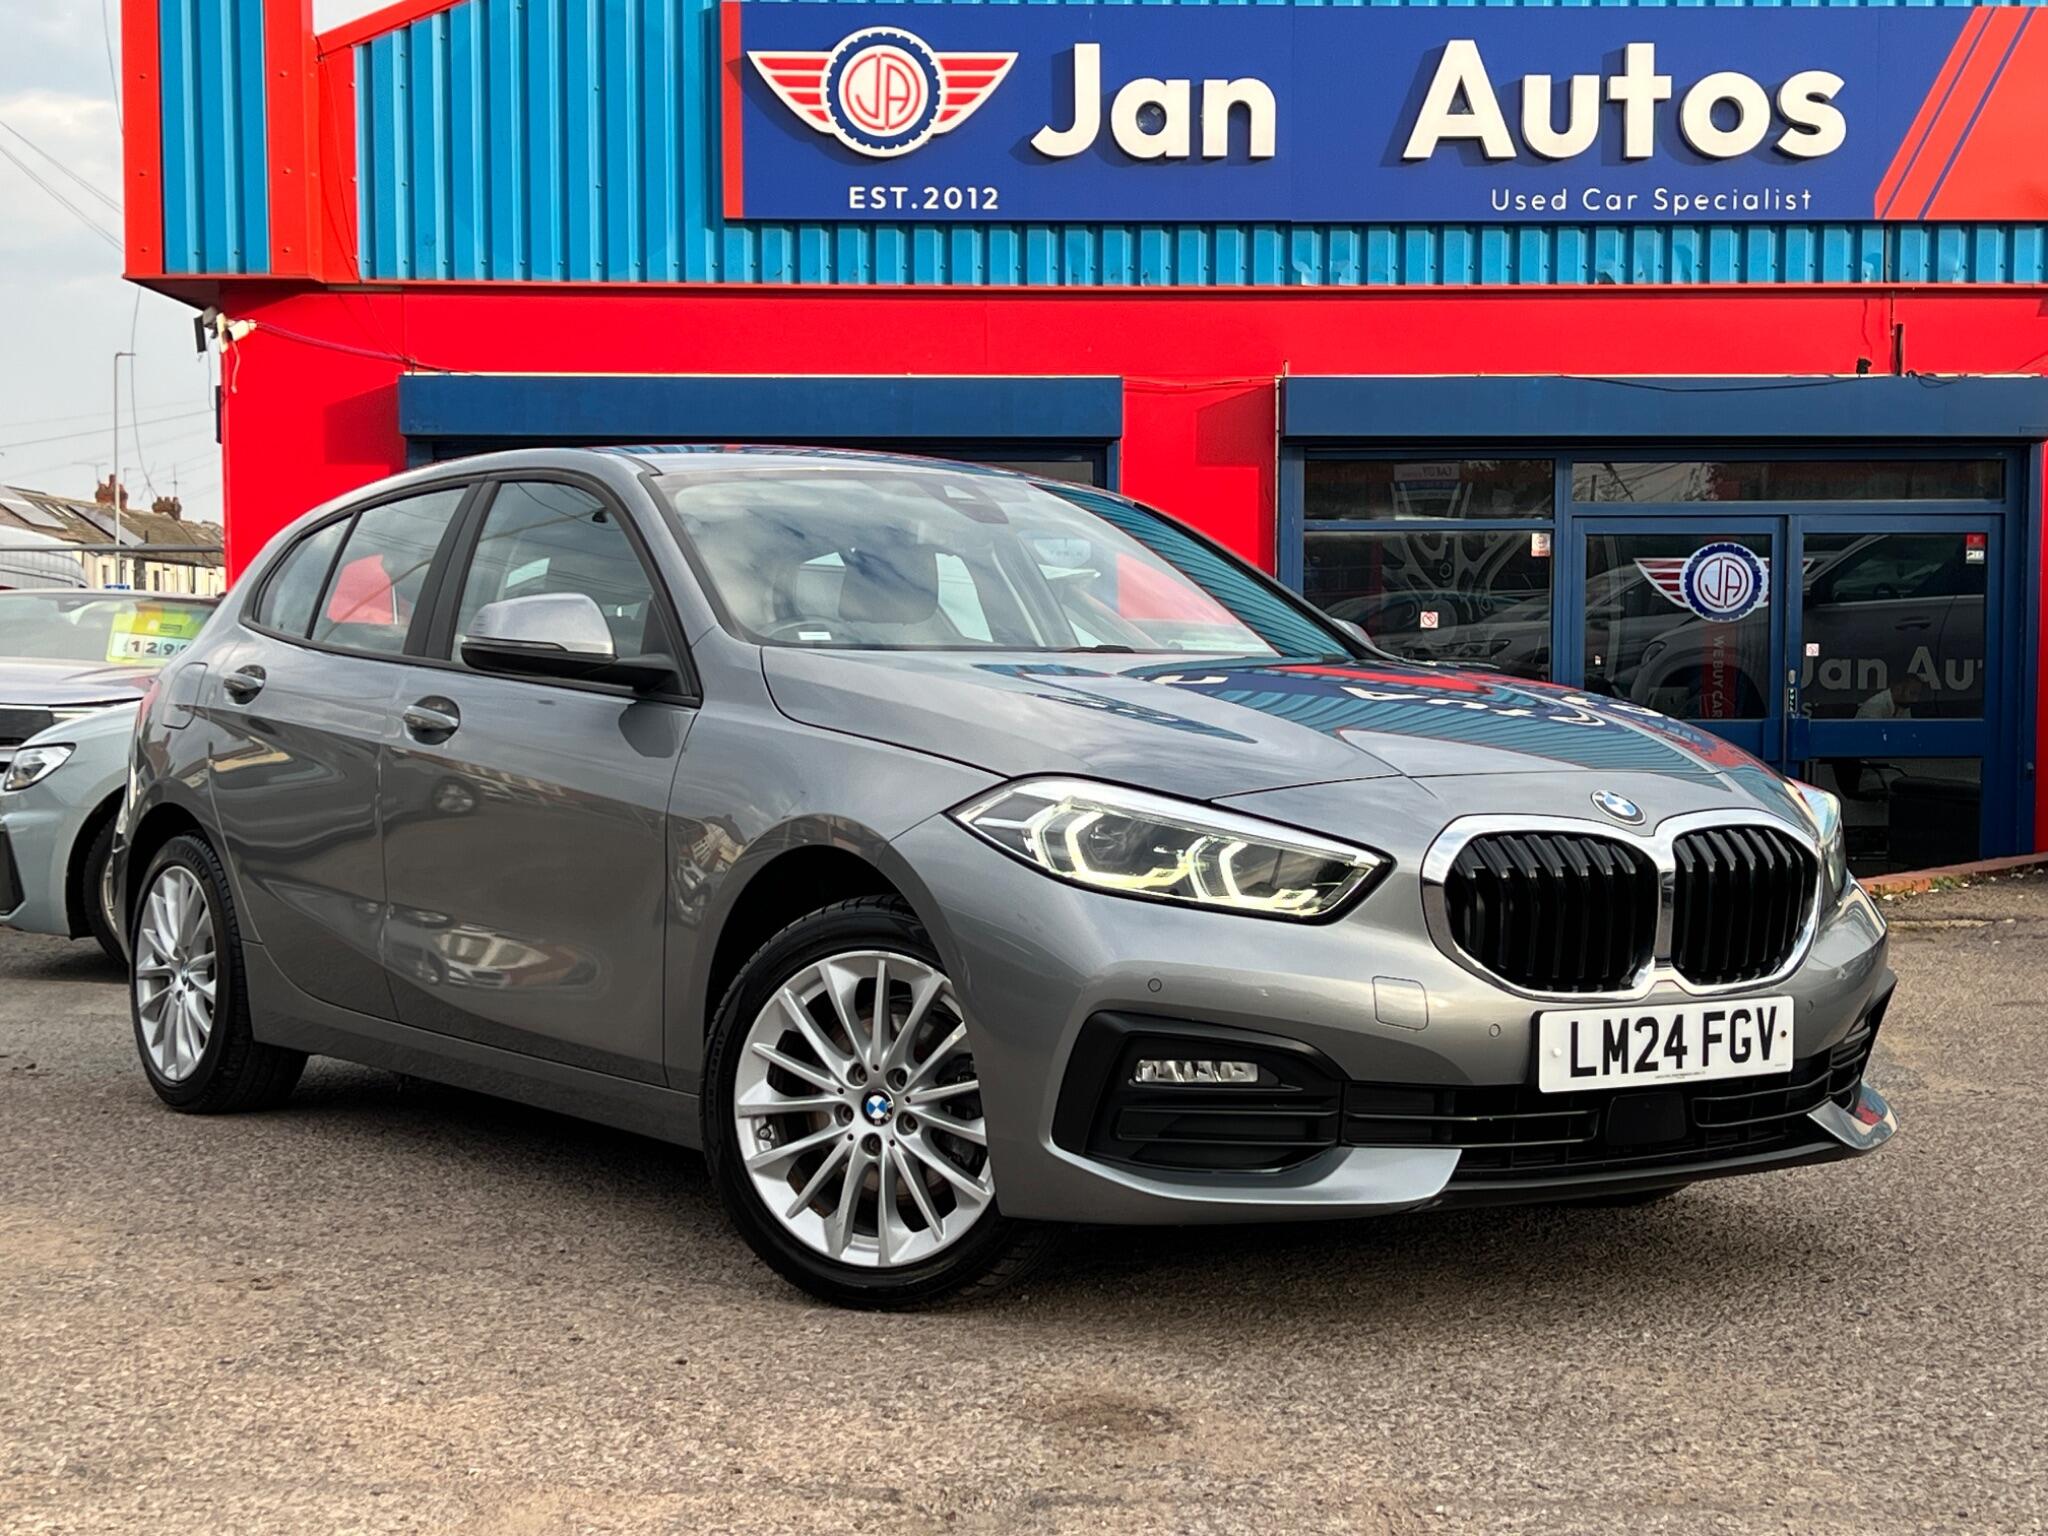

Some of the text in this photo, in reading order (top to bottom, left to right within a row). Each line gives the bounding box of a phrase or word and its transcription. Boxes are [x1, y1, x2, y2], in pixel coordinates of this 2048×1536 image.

[1031, 39, 1847, 159] Jan Autos
[849, 186, 999, 210] EST.2012
[1491, 187, 1812, 216] Used Car Specialist
[1711, 660, 1724, 688] BUY
[1570, 1006, 1777, 1078] LM24 FGV
